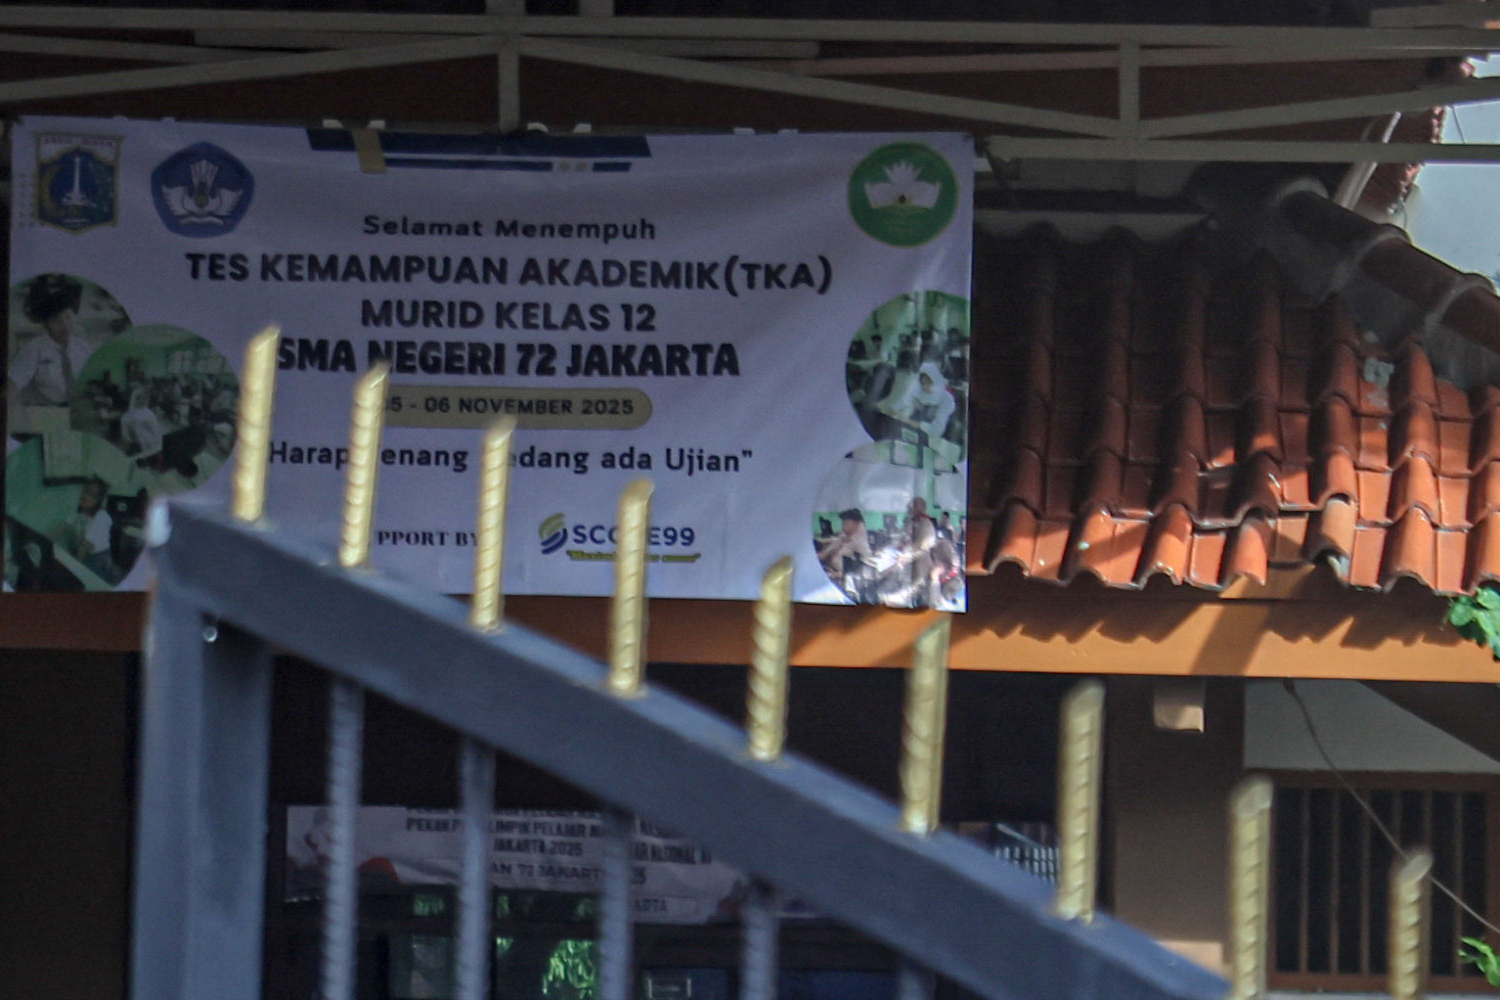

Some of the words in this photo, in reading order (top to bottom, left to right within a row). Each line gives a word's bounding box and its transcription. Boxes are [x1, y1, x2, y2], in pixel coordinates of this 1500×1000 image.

[363, 214, 484, 237] Selamat
[495, 218, 656, 245] Menempuh
[185, 252, 250, 282] TES
[260, 253, 509, 285] KEMAMPUAN
[518, 255, 833, 298] AKADEMIK(TKA)
[361, 298, 485, 329] MURID
[495, 301, 610, 332] KELAS
[620, 302, 657, 332] 12
[277, 336, 358, 373] SMA
[367, 339, 507, 376] NEGERI
[516, 342, 558, 377] 72
[565, 342, 741, 378] JAKARTA
[424, 396, 451, 414] 06
[458, 397, 573, 415] NOVEMBER
[581, 399, 635, 416] 2025
[380, 449, 469, 473] enang
[508, 446, 590, 474] edang
[600, 446, 653, 470] ada
[665, 447, 753, 477] Ujian"
[377, 530, 449, 547] PPORT
